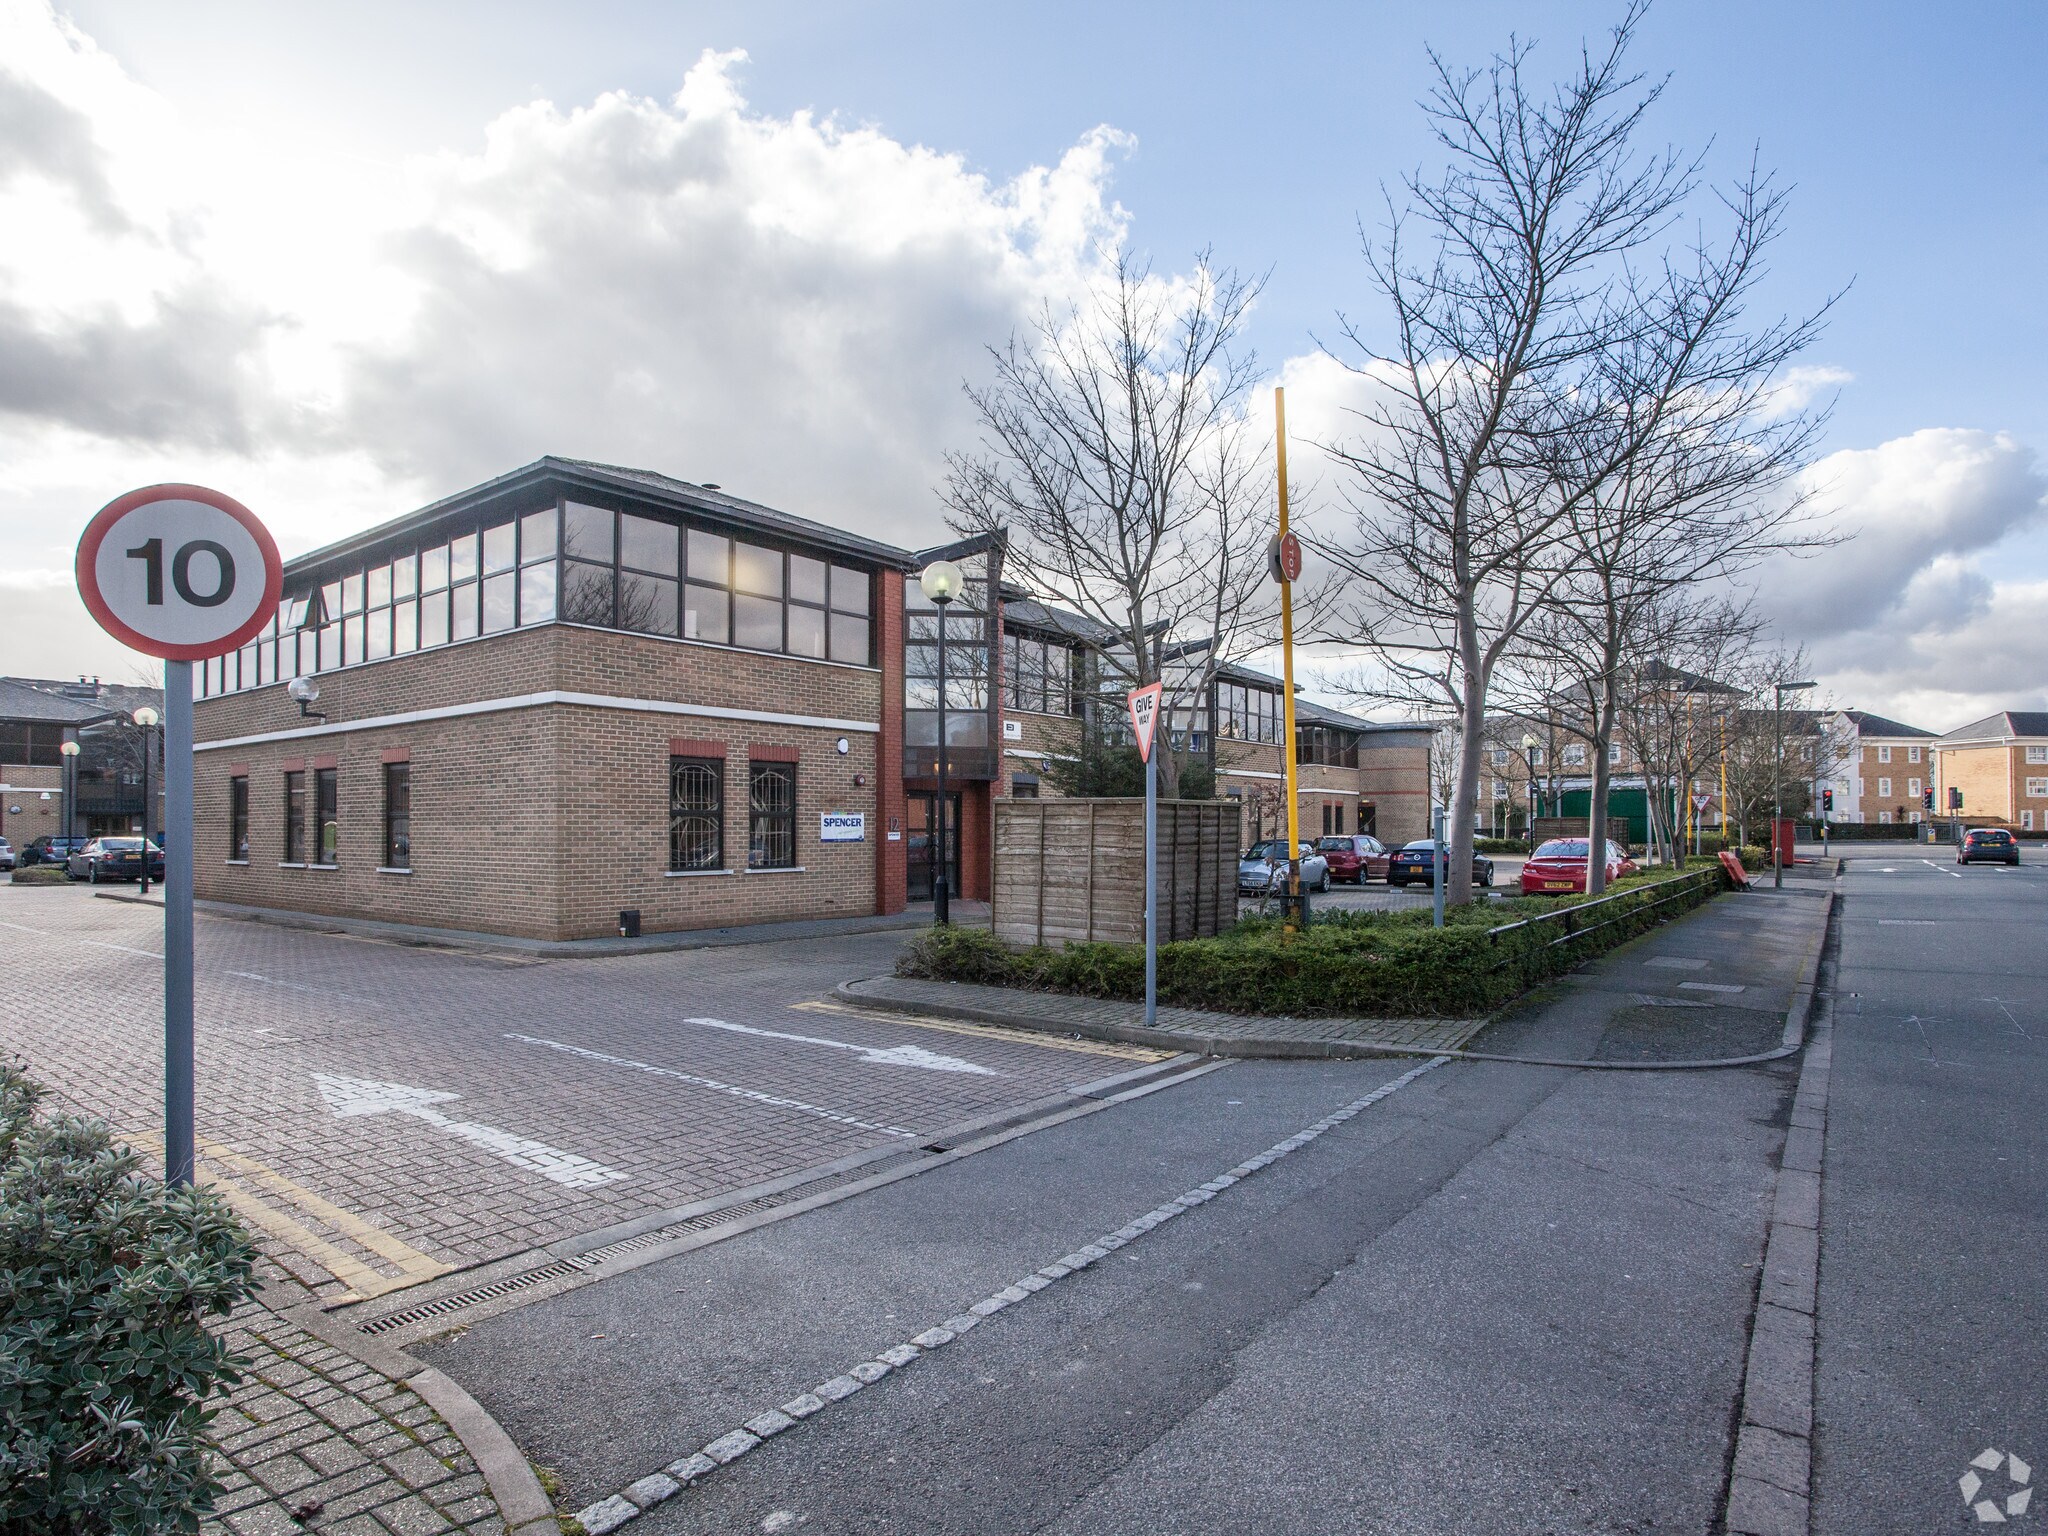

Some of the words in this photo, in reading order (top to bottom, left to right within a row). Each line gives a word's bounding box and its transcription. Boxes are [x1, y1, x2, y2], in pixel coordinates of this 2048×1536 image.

[126, 538, 236, 607] 10
[1136, 695, 1152, 713] GIVE
[1138, 714, 1150, 725] WAY
[823, 817, 862, 827] SPENCER
[890, 817, 900, 831] 12
